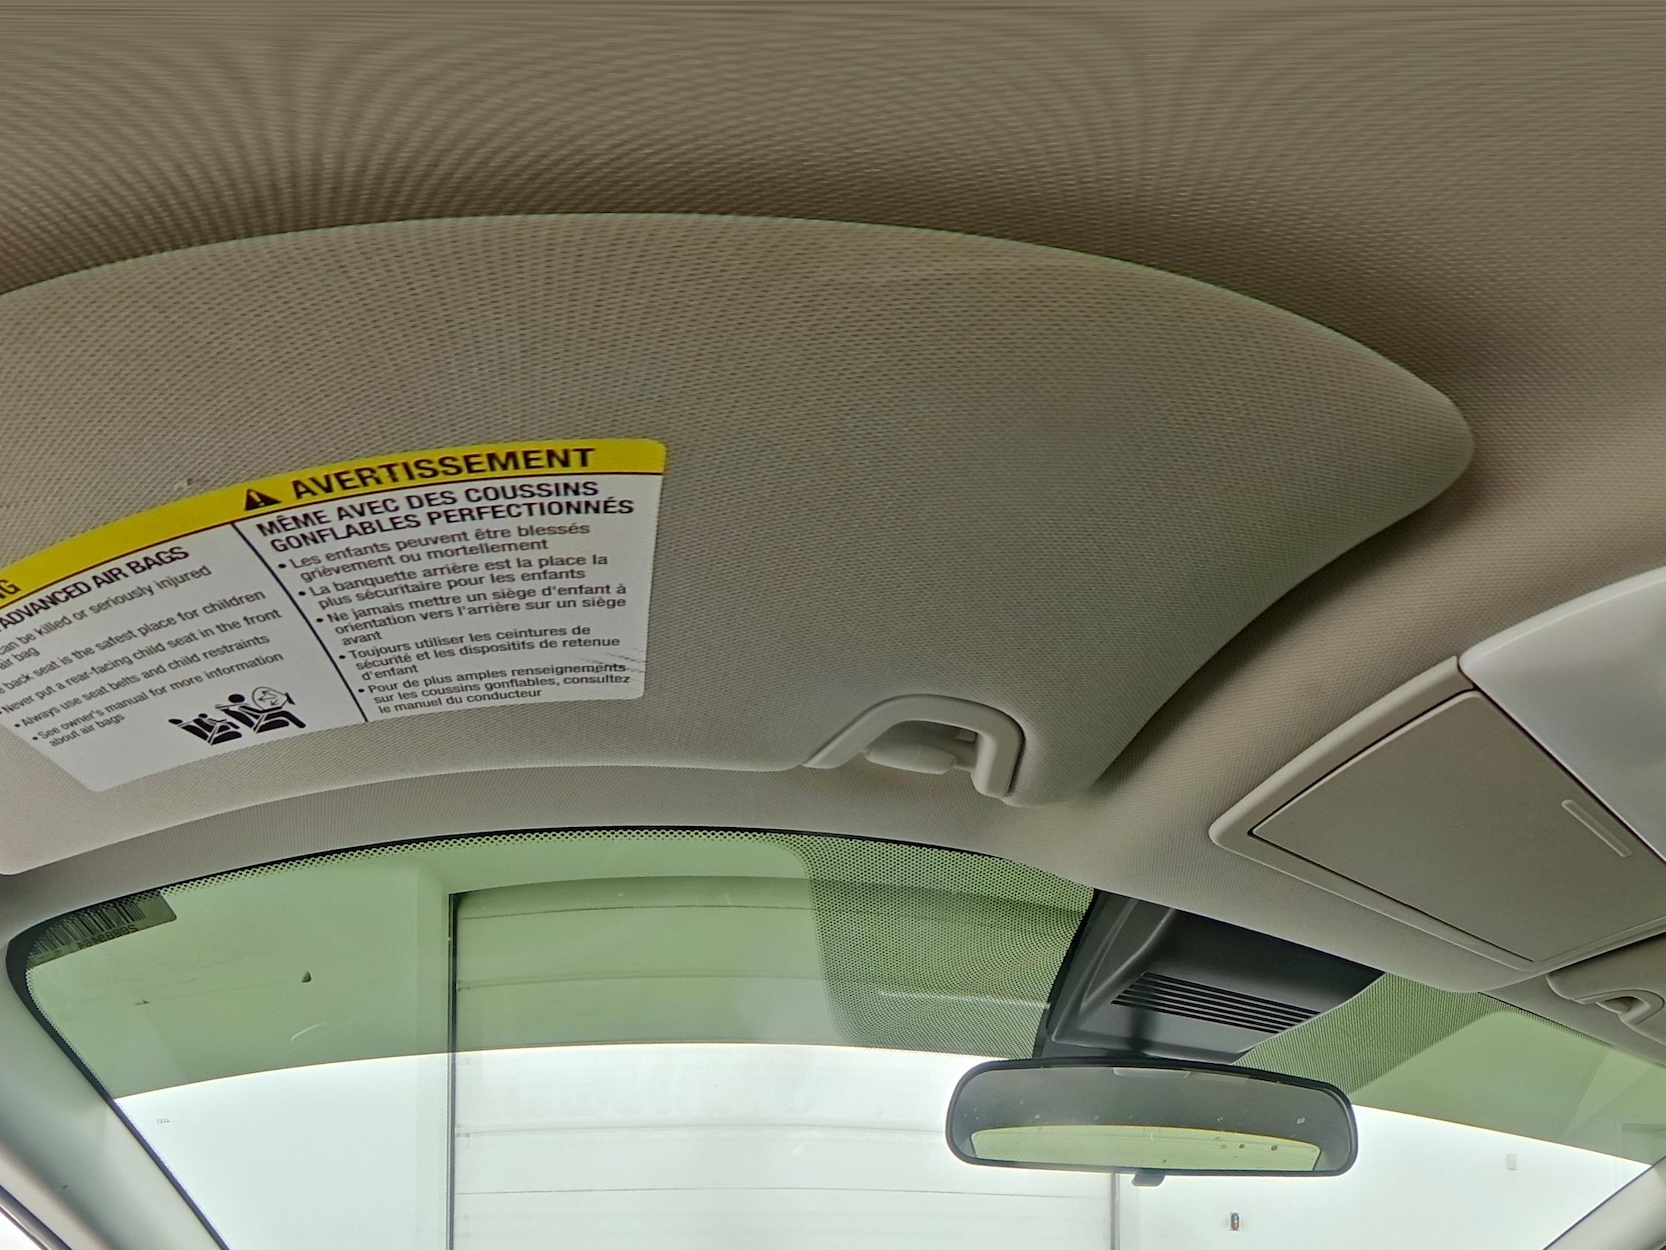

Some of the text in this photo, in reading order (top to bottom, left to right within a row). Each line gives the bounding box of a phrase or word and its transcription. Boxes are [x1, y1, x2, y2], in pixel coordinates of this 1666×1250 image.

[291, 448, 595, 500] AVERTISSEMENT
[257, 482, 599, 537] MÊME AVEC DES COUSSINS
[270, 497, 634, 552] GONFLABLES PERFECTIONNÉS
[289, 523, 590, 569] Les enfants peuvent être blessés
[300, 539, 549, 583] grièvement ou mortellement
[91, 567, 130, 588] AIR
[126, 546, 190, 575] BAGS
[309, 554, 608, 597] La banquette arrière est la place la
[17, 631, 36, 644] be
[34, 616, 72, 637] killed
[72, 609, 87, 620] or
[89, 585, 155, 614] seriously
[156, 565, 212, 590] injured
[318, 569, 586, 610] plus sécuritaire pour les enfants
[327, 584, 627, 623] Ne jamais mettre un siège d'enfant à
[335, 597, 627, 634] orientation vers l'arrière sur un siège
[0, 655, 13, 669] air
[16, 646, 40, 662] bag
[5, 674, 34, 690] back
[33, 661, 61, 678] seat
[61, 655, 73, 665] is
[71, 645, 95, 660] the
[96, 630, 137, 651] safest
[137, 617, 178, 637] place
[177, 609, 199, 623] for
[202, 590, 266, 615] children
[342, 631, 383, 646] avant
[348, 626, 591, 659] Toujours utiliser les ceintures de
[355, 638, 621, 670] sécurité et les dispositifs de retenue
[1, 608, 282, 714] Never put a rear-facing child seat in the front
[21, 634, 271, 726] Always use seat belts and child restraints
[361, 664, 419, 681] d'enfant
[368, 663, 627, 694] Pour de plus amples renseignements
[38, 653, 284, 739] See owner's manual for more information
[373, 674, 631, 704] sur les coussins gonflables, consultez
[378, 688, 542, 714] le manuel du conducteur
[49, 713, 125, 747] about air bags
